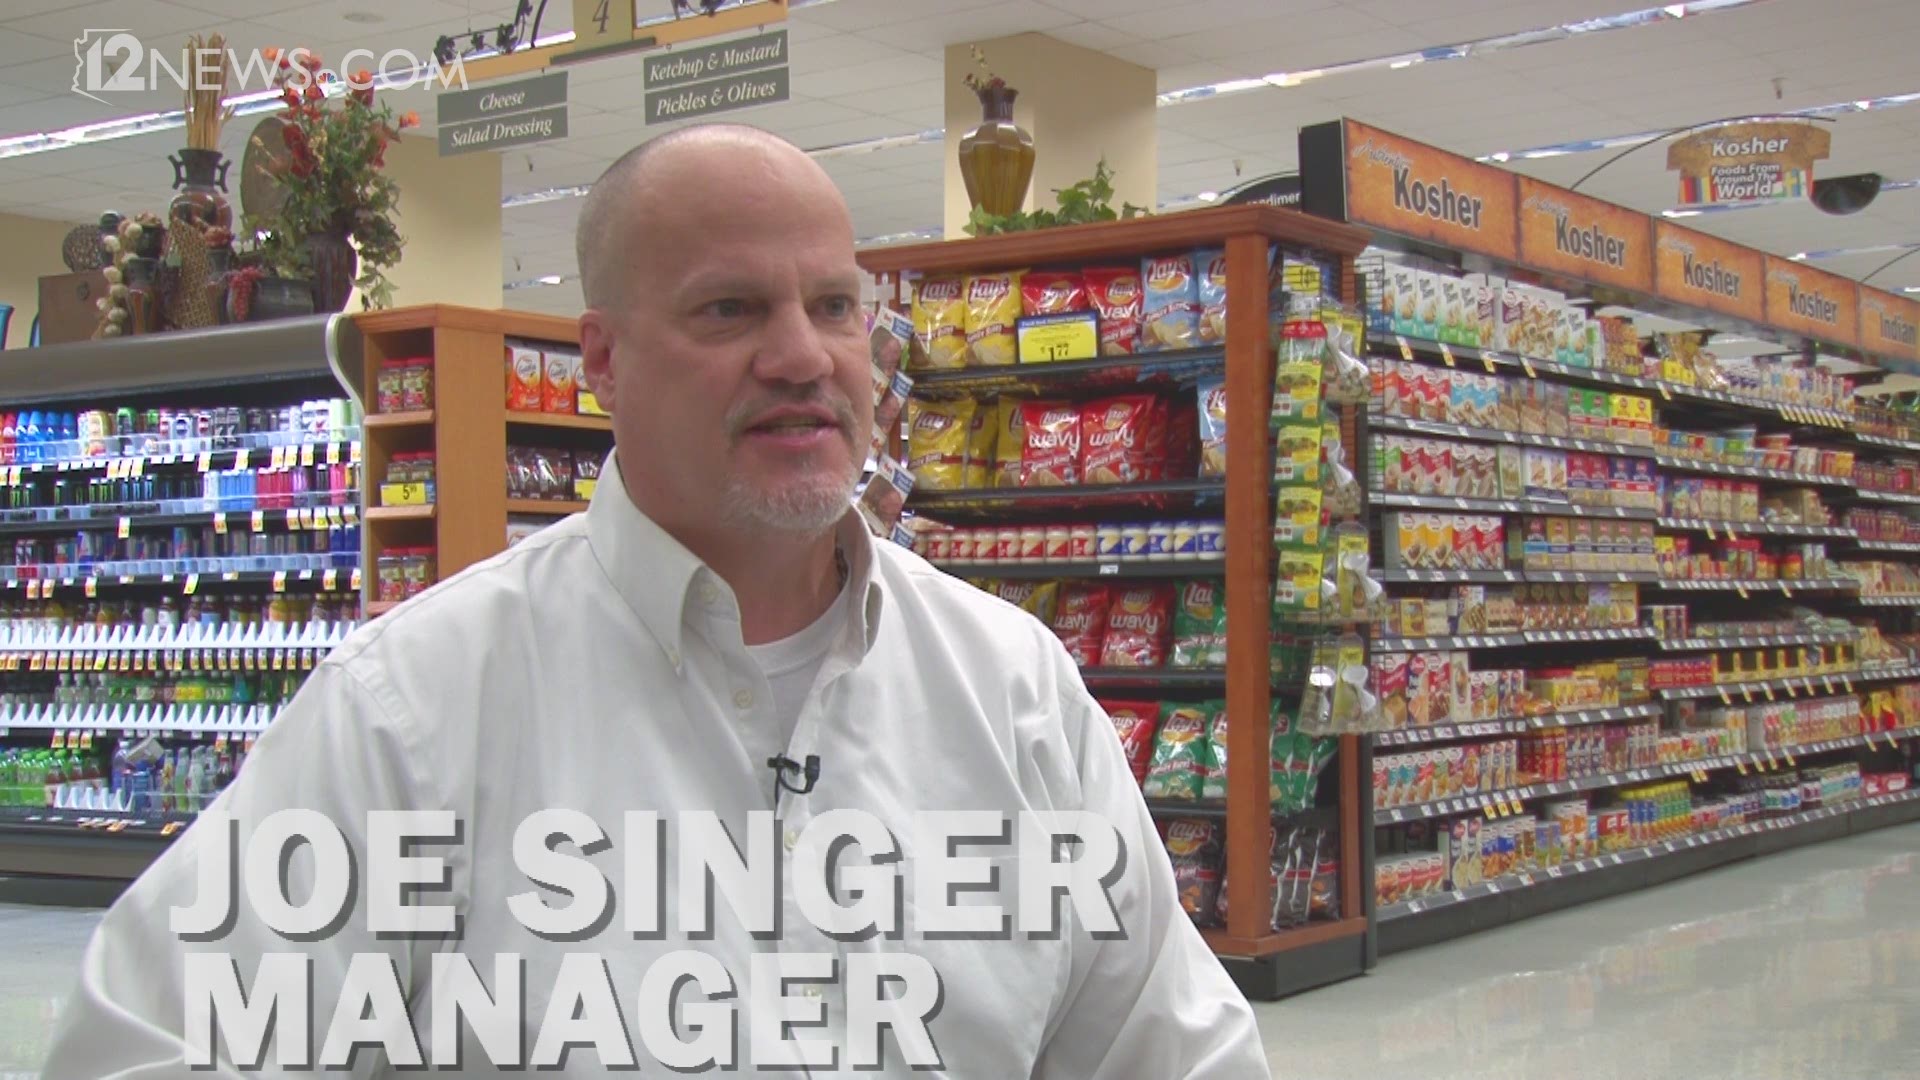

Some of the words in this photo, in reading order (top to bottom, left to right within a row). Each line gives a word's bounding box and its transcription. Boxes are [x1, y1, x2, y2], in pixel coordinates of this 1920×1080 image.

[591, 0, 609, 34] 4
[649, 58, 704, 83] Ketchup
[707, 52, 718, 70] &
[721, 39, 781, 68] Mustard
[479, 89, 525, 112] Cheese
[656, 93, 707, 117] Pickles
[711, 87, 723, 106] &
[727, 80, 776, 103] Olives
[451, 126, 490, 148] Salad
[493, 117, 552, 141] Dressing
[1712, 137, 1788, 157] Kosher
[1749, 163, 1780, 174] From
[1393, 166, 1482, 231] Kosher
[1717, 180, 1771, 198] World
[1555, 213, 1625, 269] Kosher
[1682, 252, 1741, 298] Kosher
[1789, 285, 1838, 324] Kosher
[1880, 312, 1916, 345] Indian
[1110, 612, 1158, 634] wavy
